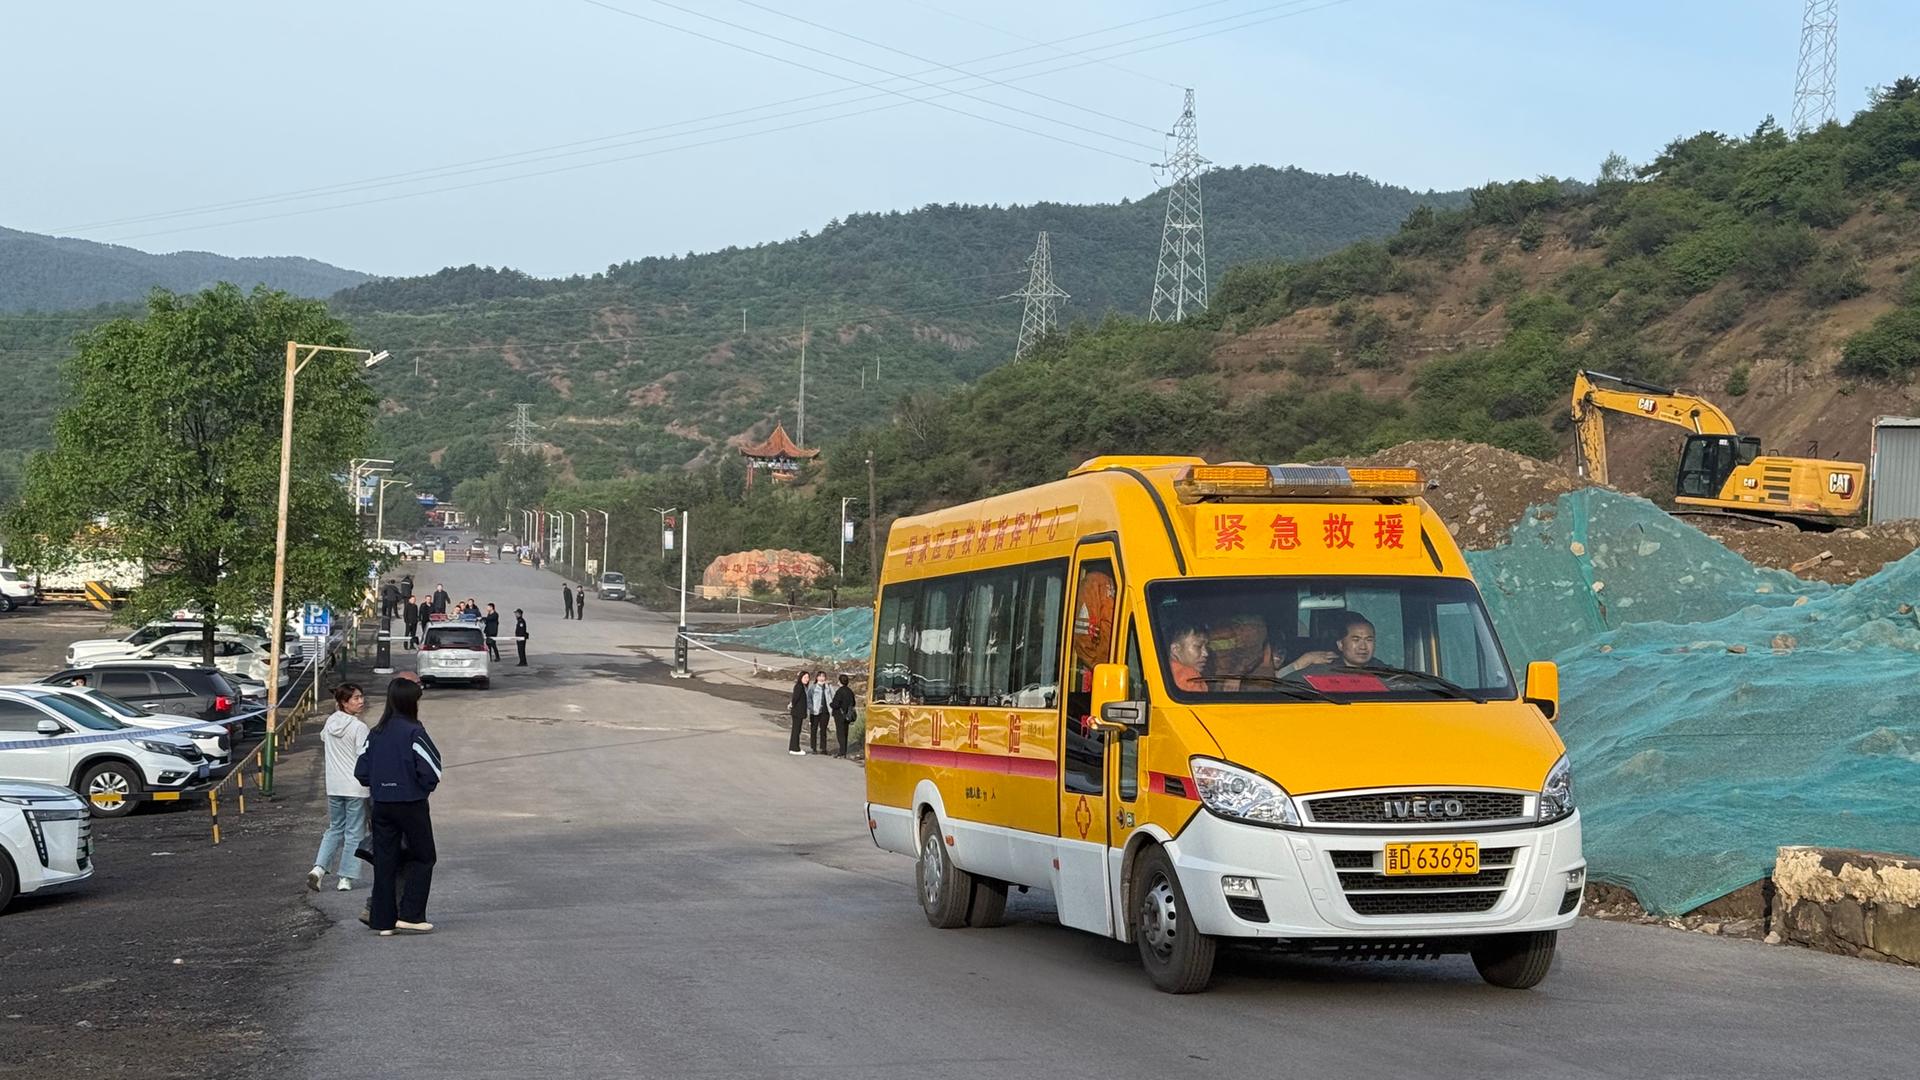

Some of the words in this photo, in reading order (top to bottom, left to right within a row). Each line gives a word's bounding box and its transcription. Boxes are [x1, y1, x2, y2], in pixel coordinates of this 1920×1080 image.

[1638, 398, 1655, 411] CAT
[1743, 478, 1756, 487] CAT
[1829, 473, 1851, 494] CAT
[1214, 513, 1405, 551] 紧急救援
[310, 604, 323, 624] P
[1384, 800, 1463, 818] IVECO
